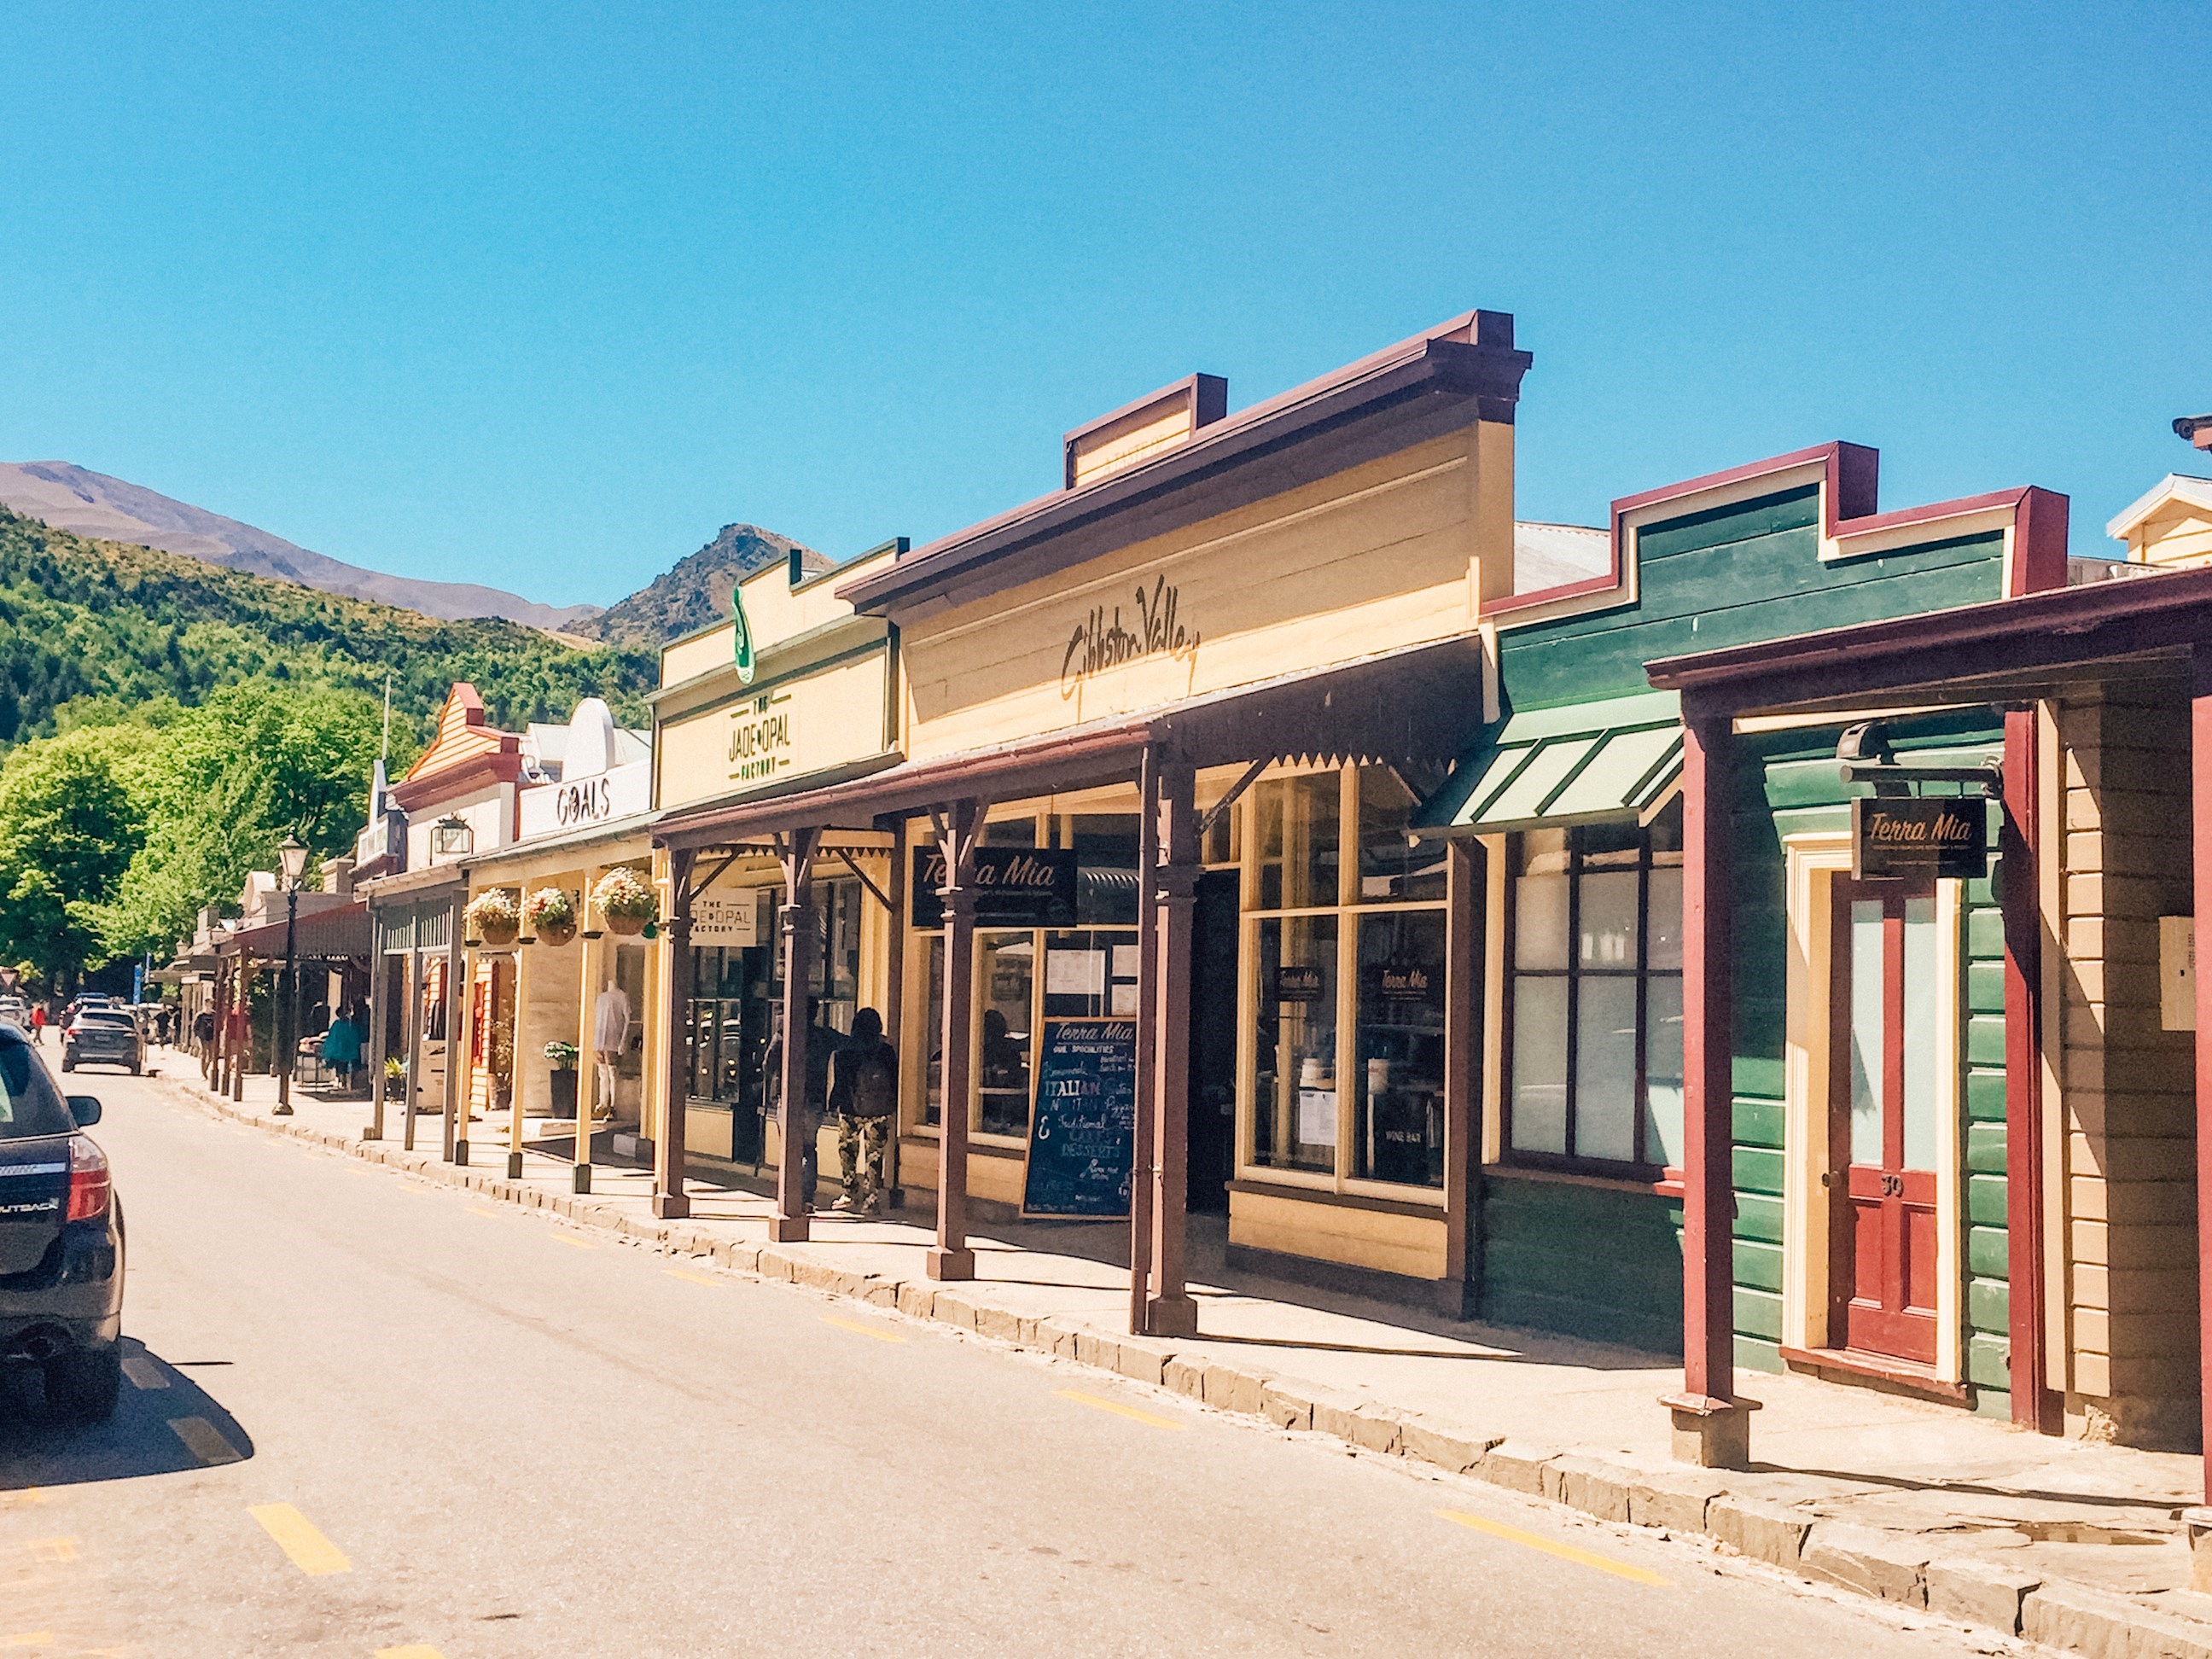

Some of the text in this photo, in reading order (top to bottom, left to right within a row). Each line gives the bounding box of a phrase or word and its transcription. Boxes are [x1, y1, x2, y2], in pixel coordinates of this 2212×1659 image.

[1061, 573, 1201, 723] Gibbston Valley
[753, 696, 768, 716] THE
[729, 723, 757, 763] JADE
[762, 713, 790, 752] OPAL
[741, 756, 776, 781] FACTORY
[557, 777, 610, 826] GOALS
[1871, 812, 1972, 841] Terra Mia
[923, 854, 1055, 886] Tea Mia
[715, 911, 751, 923] OPAL
[1056, 1022, 1133, 1040] Terra Mia
[1045, 1080, 1101, 1097] ITALIAN
[0, 1201, 59, 1213] UTBACK
